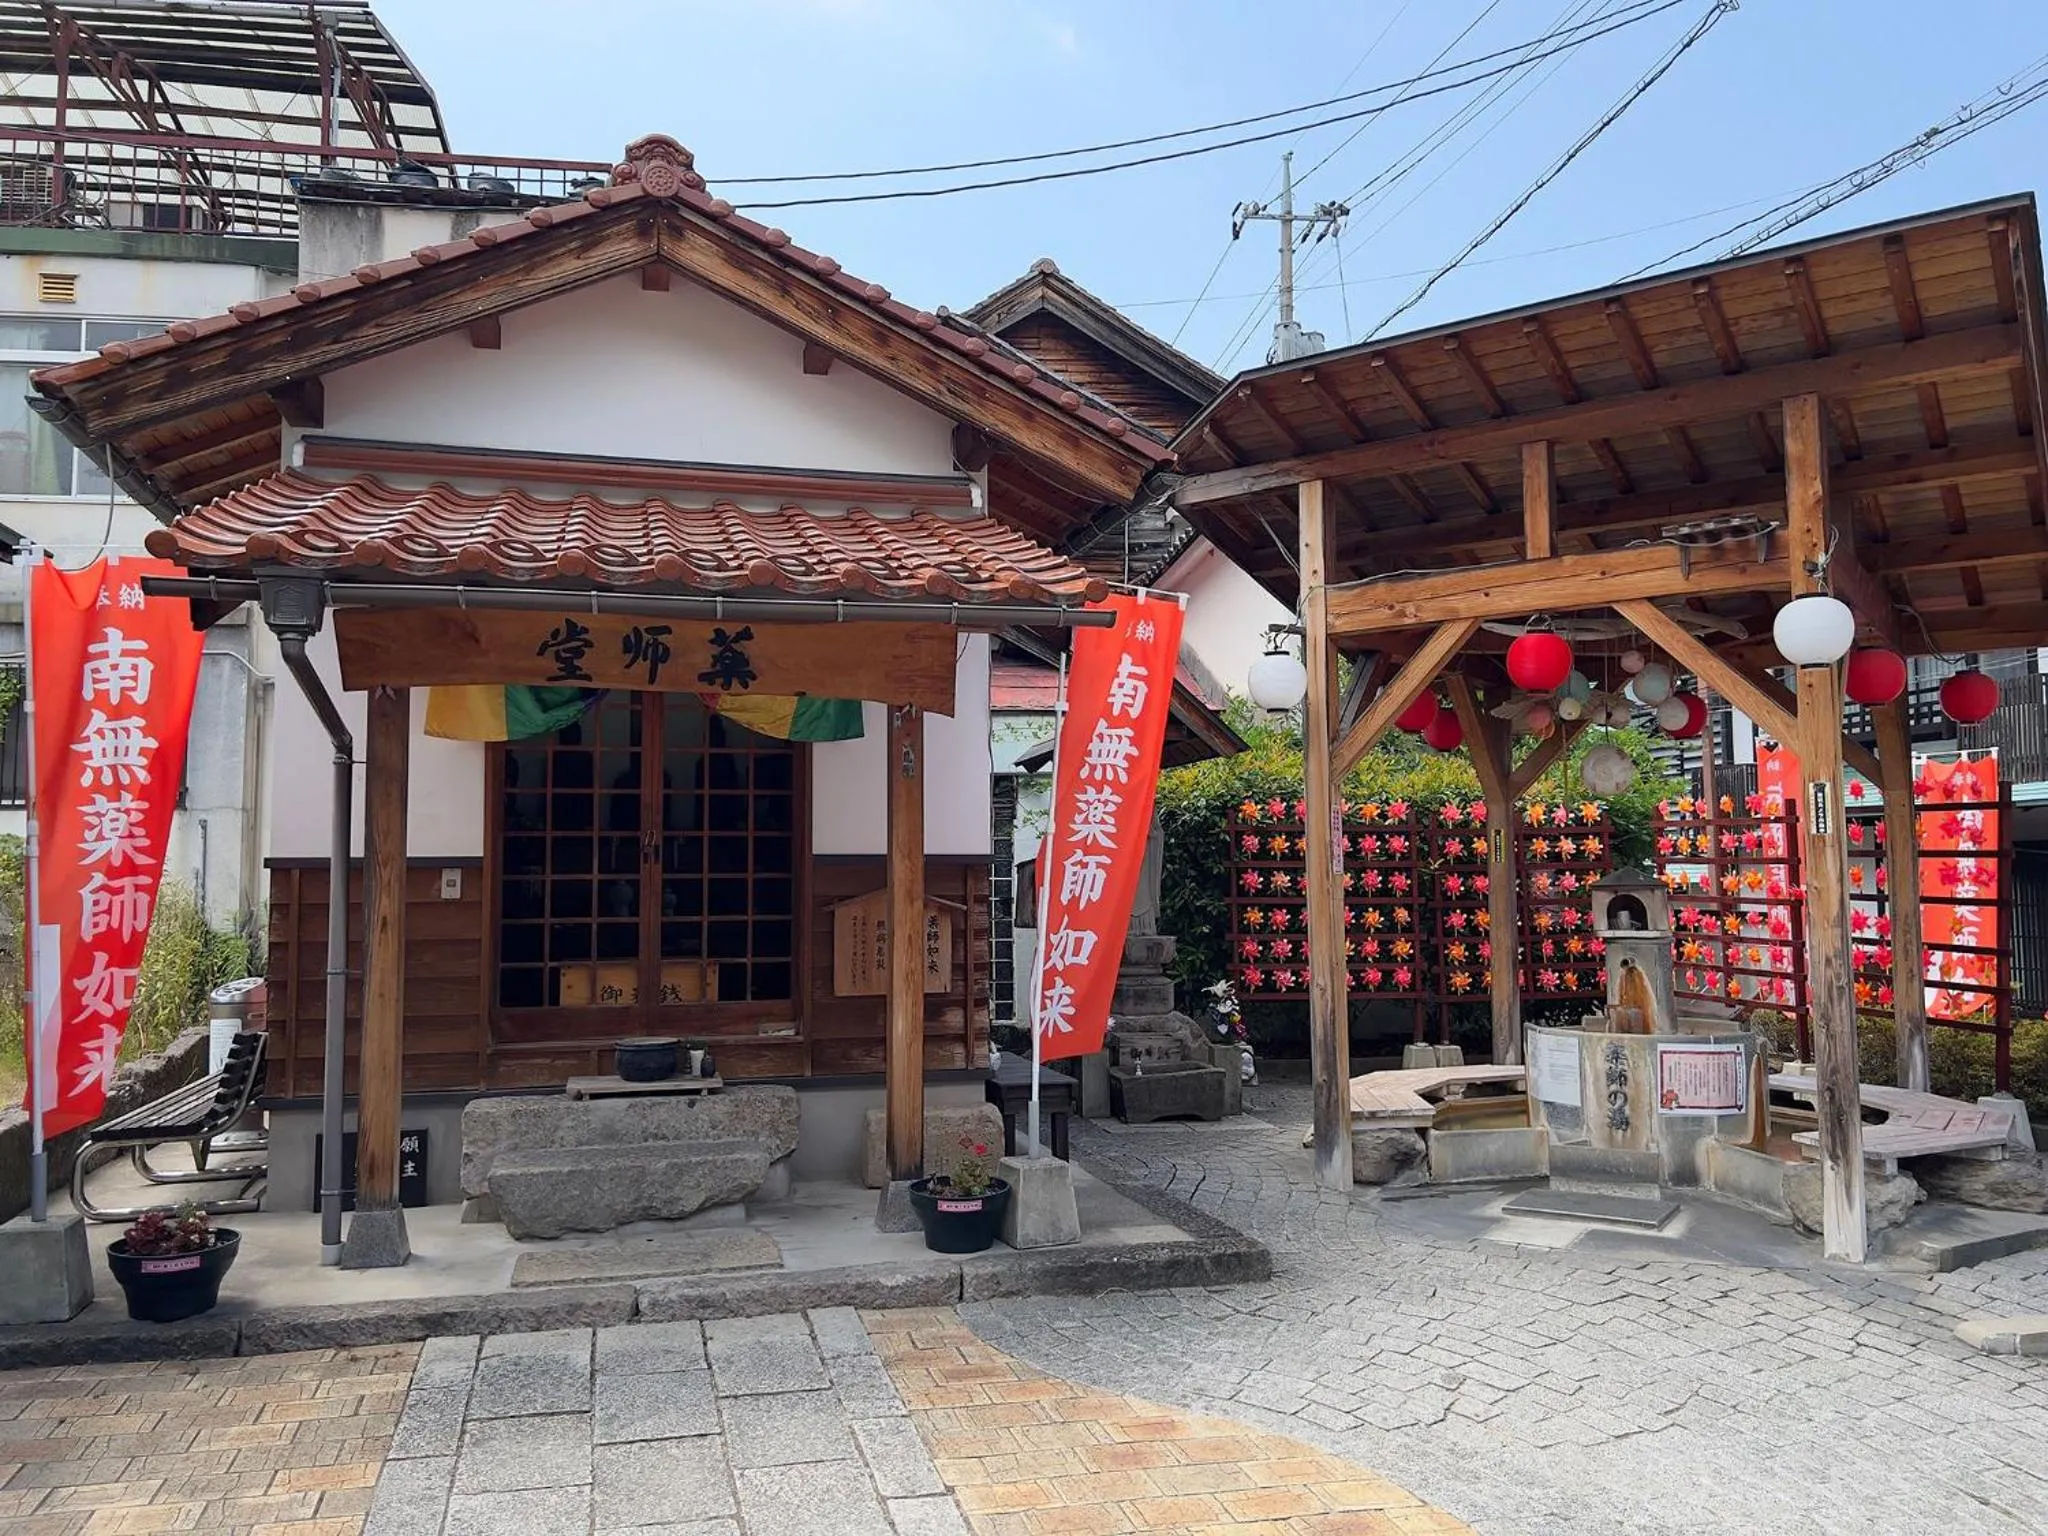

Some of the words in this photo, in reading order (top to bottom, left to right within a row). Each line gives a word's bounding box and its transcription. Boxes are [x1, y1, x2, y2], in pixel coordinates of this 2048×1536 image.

[68, 627, 159, 1097] 南無薬師如来
[1039, 651, 1150, 1038] 南無薬師如来
[600, 983, 683, 1004] 御銭
[400, 1135, 420, 1177] 願主
